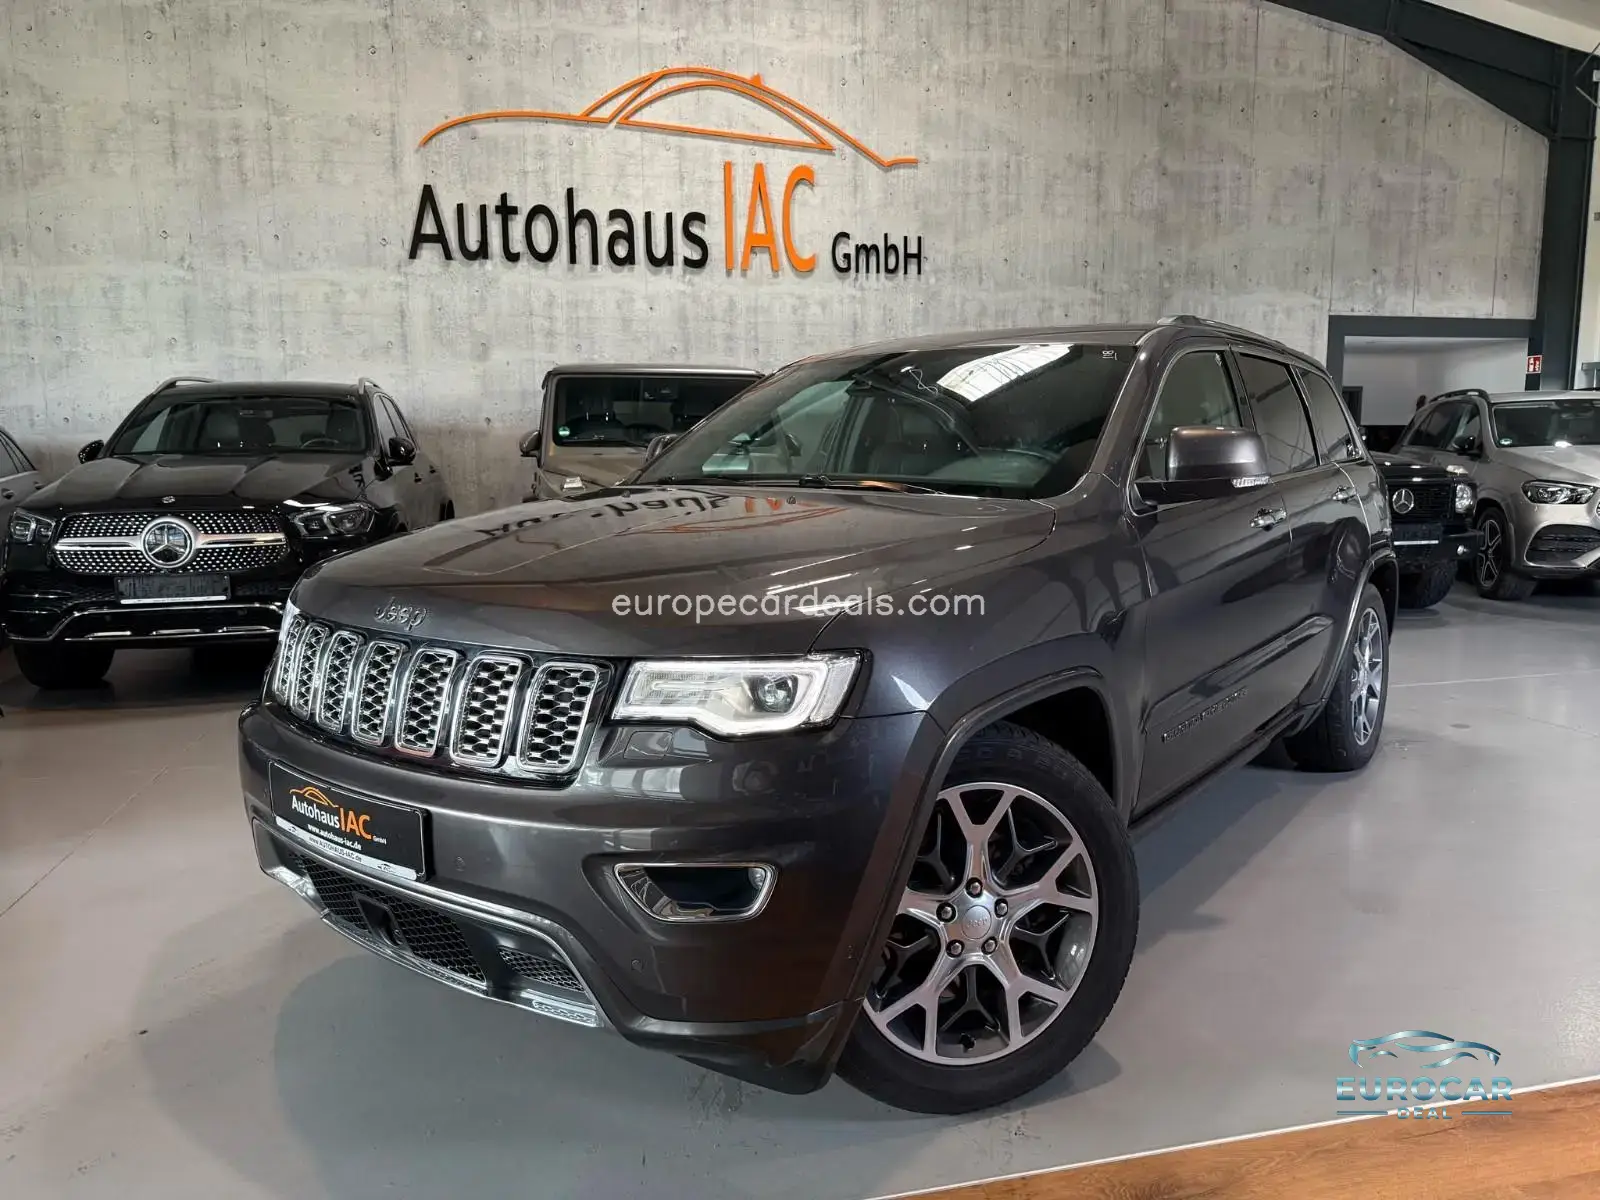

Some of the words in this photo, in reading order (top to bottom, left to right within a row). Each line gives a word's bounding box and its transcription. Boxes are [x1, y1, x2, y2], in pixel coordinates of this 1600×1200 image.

[408, 184, 710, 268] Autohaus
[724, 161, 817, 273] IAC
[831, 231, 924, 276] GmbH
[374, 597, 427, 632] Jeep
[291, 795, 340, 829] Autohaus
[339, 807, 372, 840] IAC
[307, 823, 362, 851] www.autohaus-iac.de
